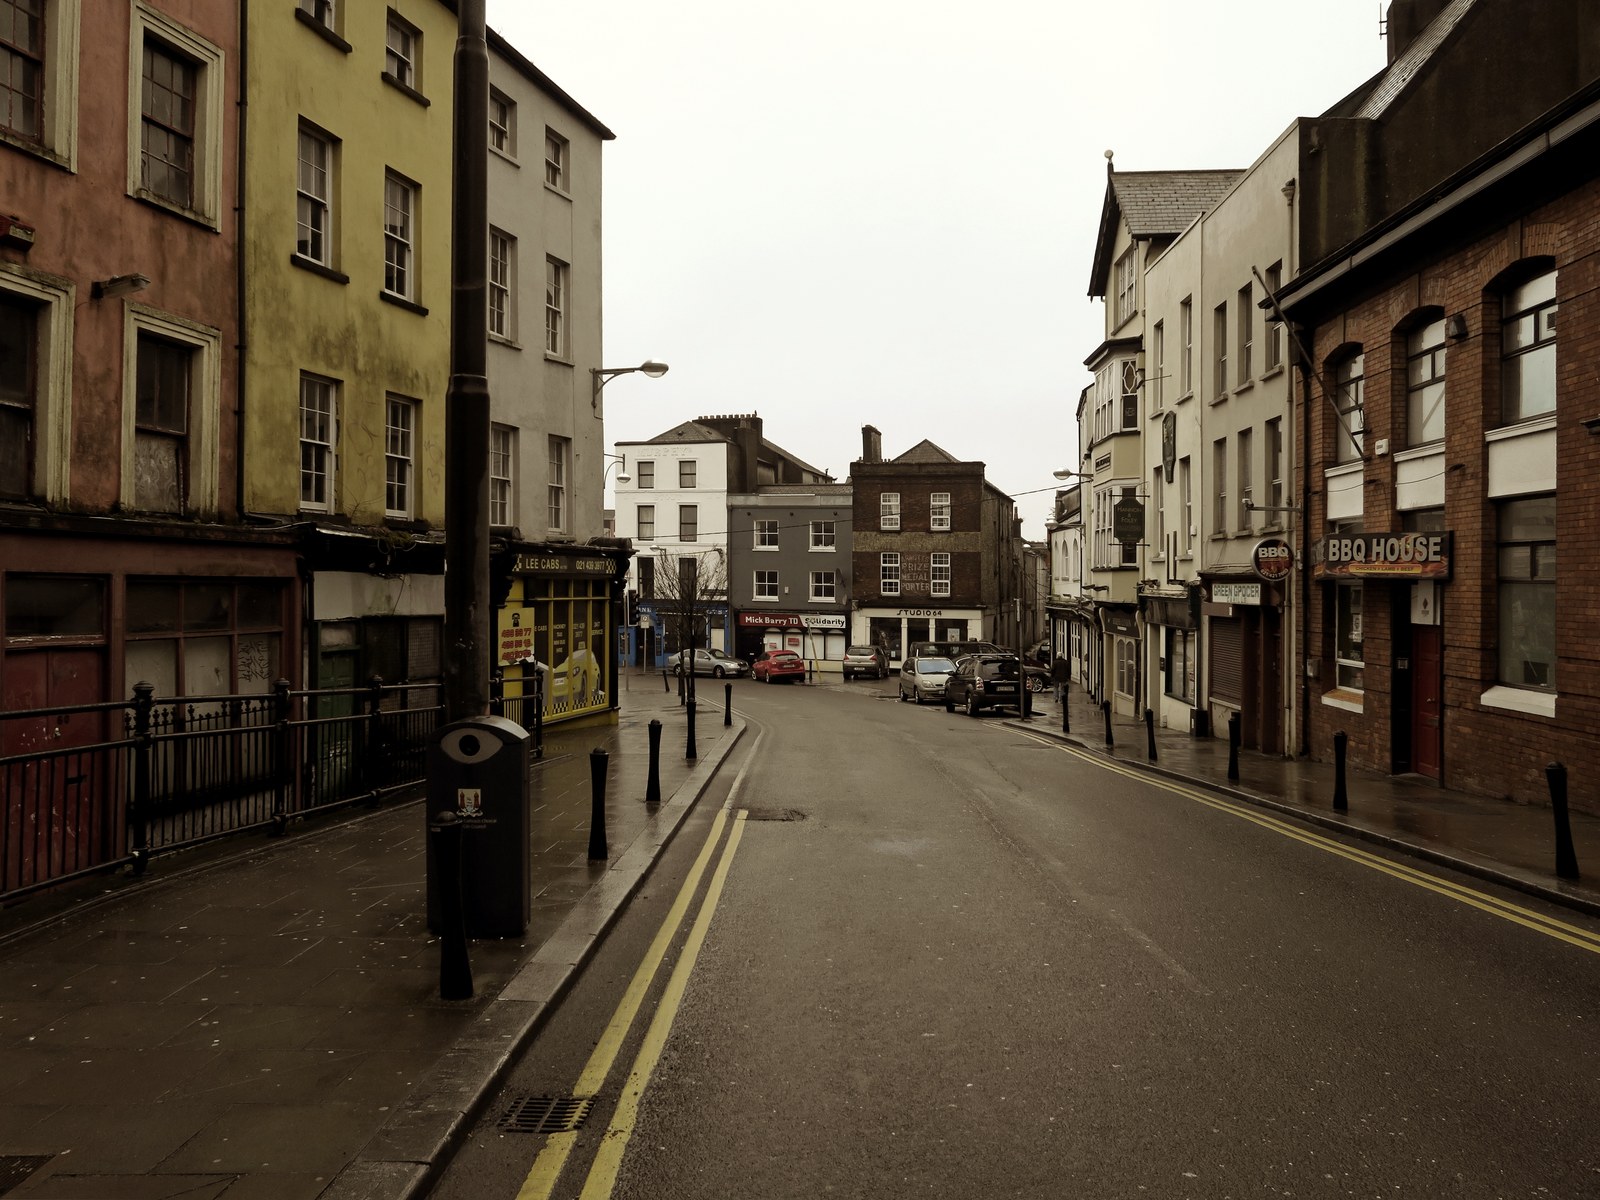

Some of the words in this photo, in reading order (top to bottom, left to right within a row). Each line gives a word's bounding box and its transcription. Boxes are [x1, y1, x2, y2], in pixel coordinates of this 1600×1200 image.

[1258, 546, 1289, 558] BBQ
[1328, 538, 1366, 563] BBQ
[1372, 536, 1441, 562] HOUSE
[525, 558, 539, 569] LEE
[541, 558, 560, 570] CABS
[901, 562, 929, 571] PRIZE
[901, 572, 928, 581] MEDAL
[901, 582, 930, 591] PORTER
[745, 616, 764, 624] Mick
[764, 616, 787, 626] Barry
[788, 617, 798, 625] TD
[524, 627, 532, 636] 77
